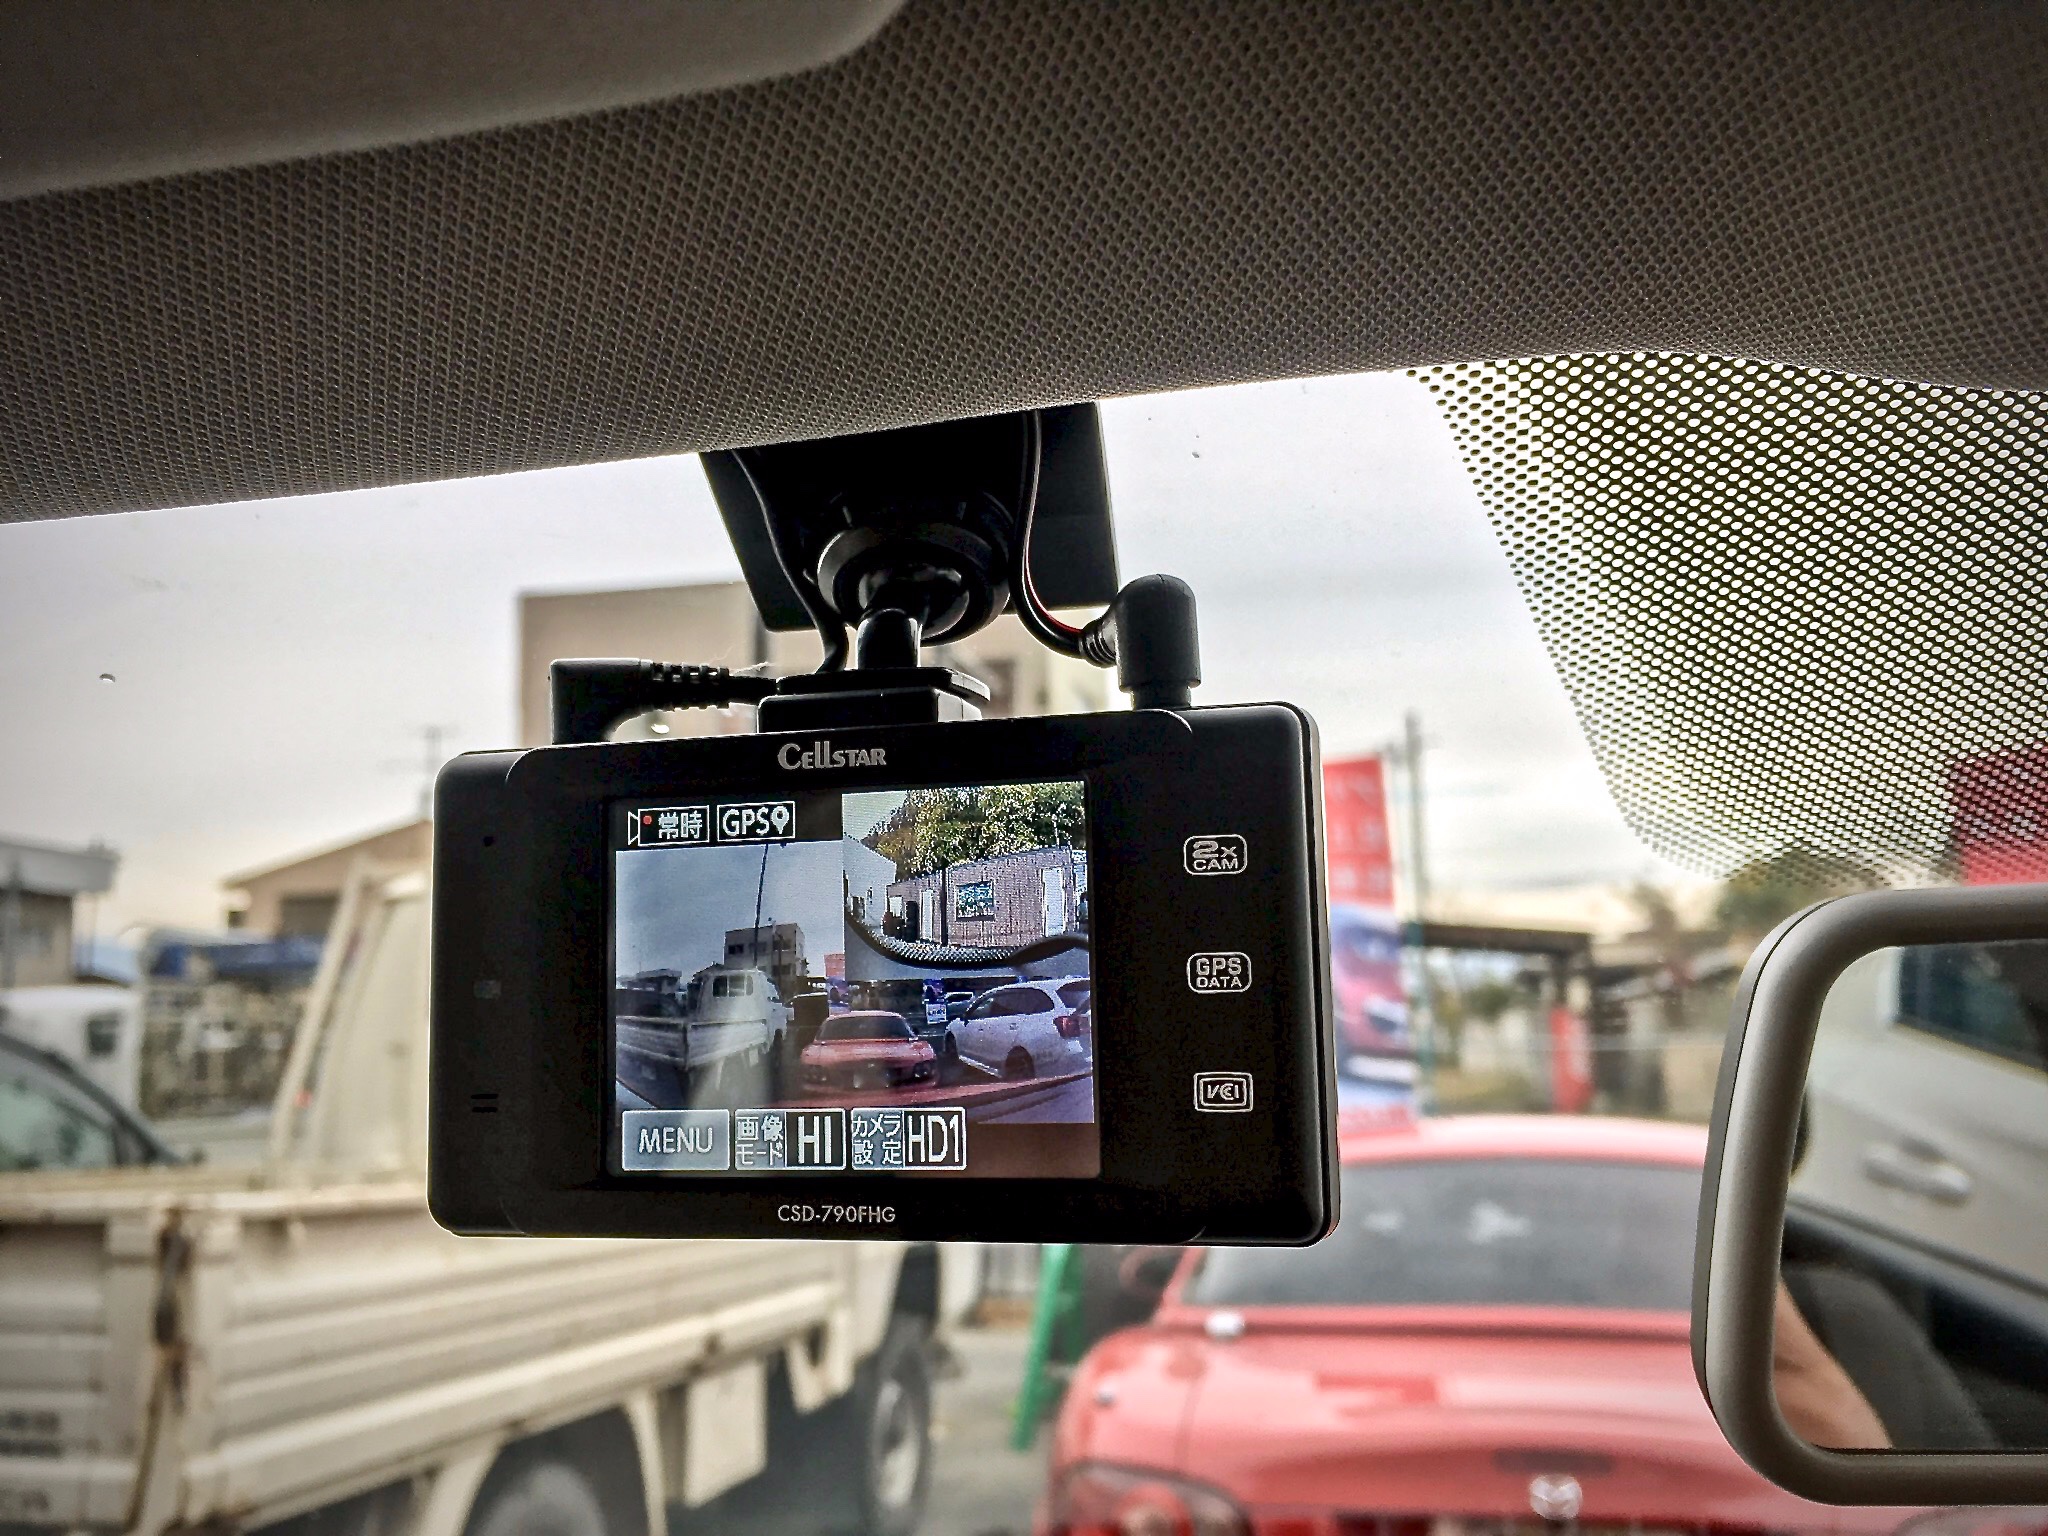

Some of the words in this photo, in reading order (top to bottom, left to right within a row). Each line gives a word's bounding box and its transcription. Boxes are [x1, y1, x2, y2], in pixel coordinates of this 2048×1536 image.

[658, 810, 703, 840] 常時
[722, 806, 771, 837] GPS
[1193, 858, 1238, 871] CAM
[1196, 957, 1242, 976] GPS
[1196, 976, 1242, 988] DATA
[736, 1115, 784, 1142] 画像
[851, 1114, 902, 1137] カメラ
[908, 1114, 961, 1164] HD1
[637, 1126, 714, 1154] MENU
[736, 1141, 784, 1166] モード
[797, 1115, 832, 1165] HI
[853, 1138, 903, 1166] 設定
[777, 1204, 897, 1223] CSD-790FHG
